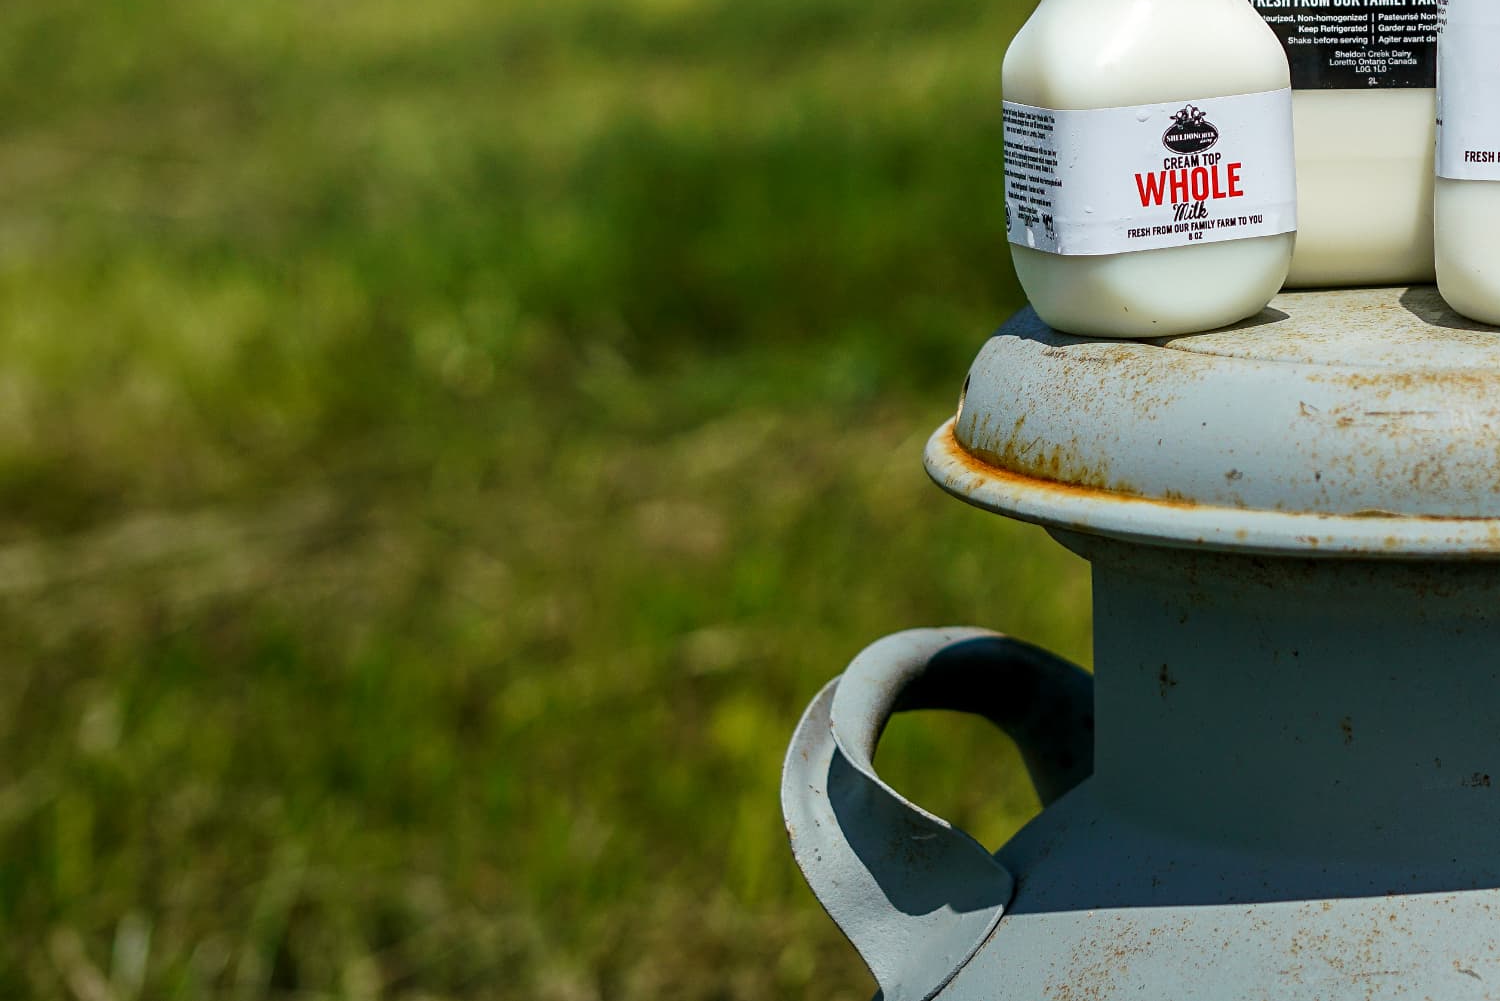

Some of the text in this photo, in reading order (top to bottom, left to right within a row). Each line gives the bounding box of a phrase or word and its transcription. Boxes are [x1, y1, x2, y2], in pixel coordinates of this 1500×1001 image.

[1297, 13, 1368, 25] Non-homogenized
[1378, 11, 1418, 22] Pasteurisé
[1298, 23, 1368, 35] Keep Refrigerated
[1378, 23, 1404, 33] Garder
[1288, 36, 1369, 46] Shake before serving
[1378, 35, 1437, 45] Agiter avant de
[1335, 50, 1413, 60] Sheldon Creek Dairy
[1329, 57, 1418, 66] Loretto Ontario Canada
[1163, 152, 1222, 170] CREAM TOP
[1464, 150, 1496, 164] FRESH
[1134, 162, 1244, 208] WHOLE
[1172, 199, 1209, 223] Milk
[1127, 214, 1263, 238] FRESH FROM OUR FAMILY FARM TO YOU
[1194, 232, 1203, 240] OZ
